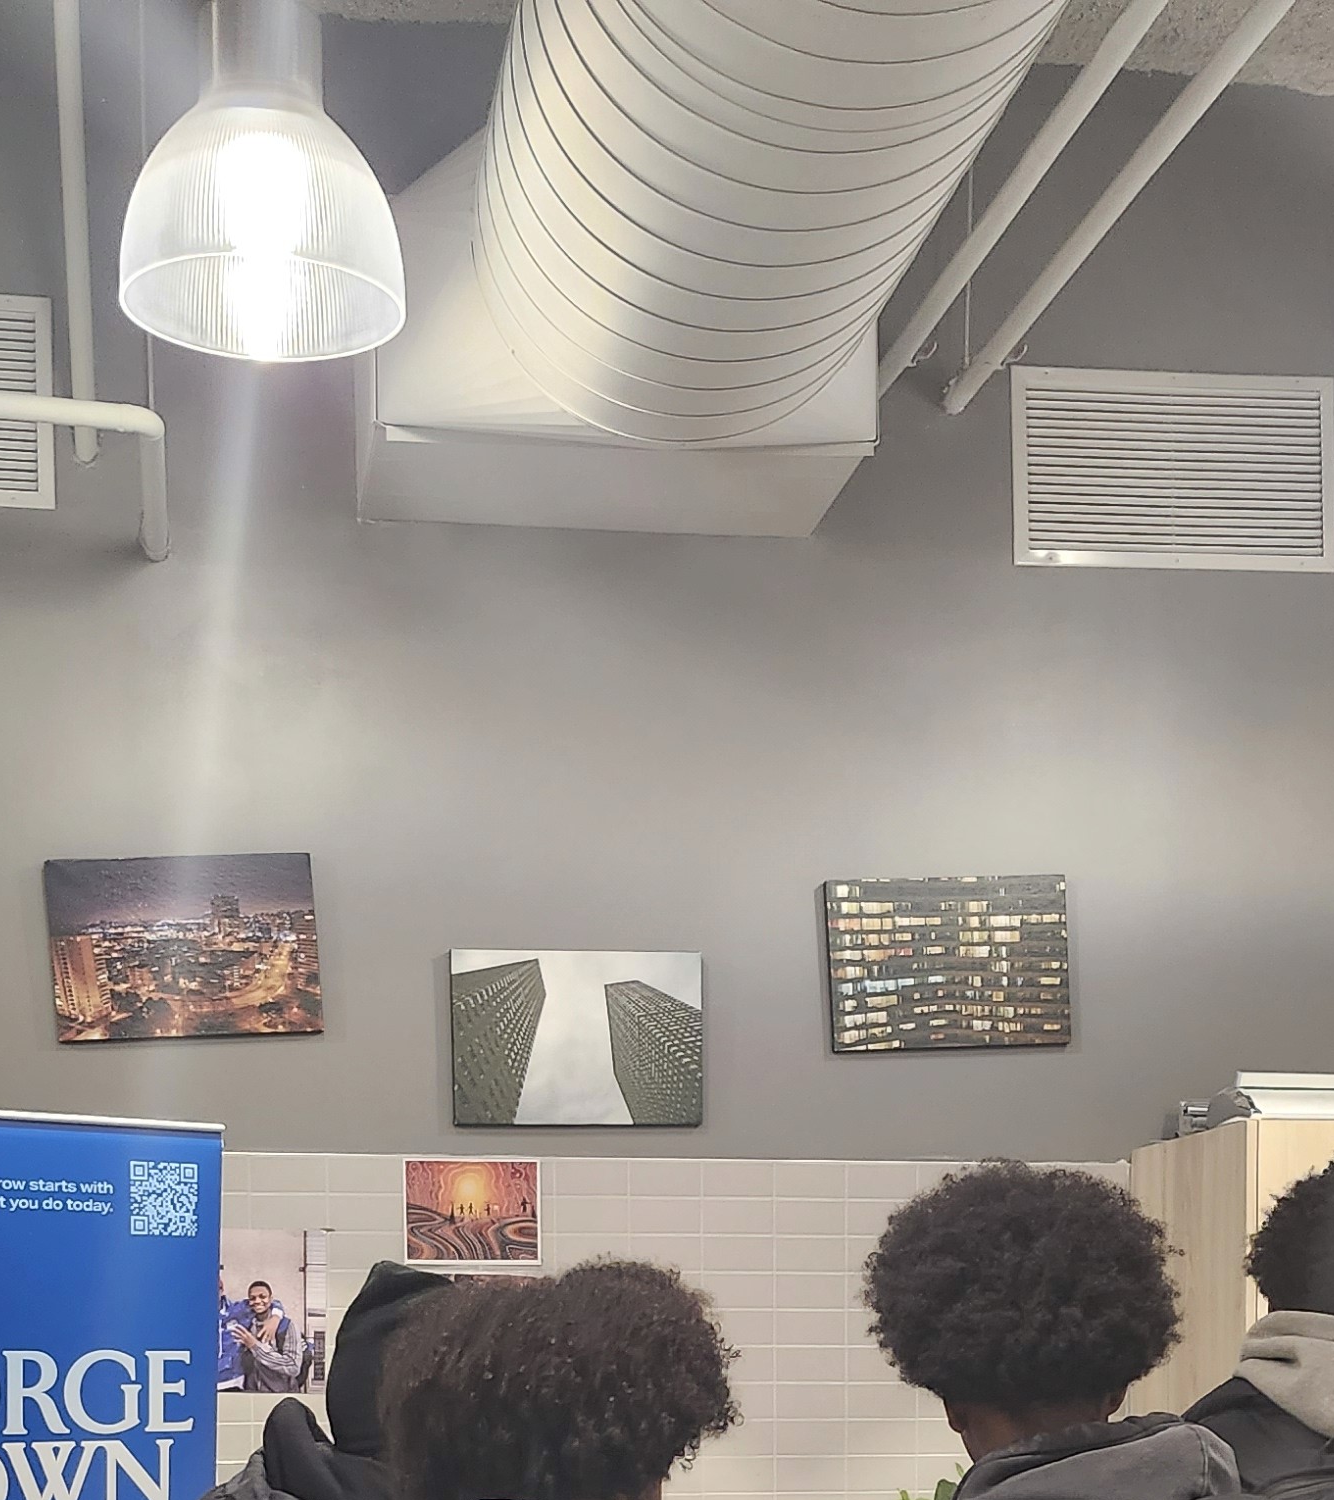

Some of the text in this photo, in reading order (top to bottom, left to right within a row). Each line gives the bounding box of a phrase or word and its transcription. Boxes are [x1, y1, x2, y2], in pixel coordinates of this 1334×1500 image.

[29, 1179, 76, 1192] starts
[80, 1181, 114, 1194] with
[9, 1198, 39, 1211] you
[42, 1198, 63, 1210] do
[66, 1200, 114, 1215] today.
